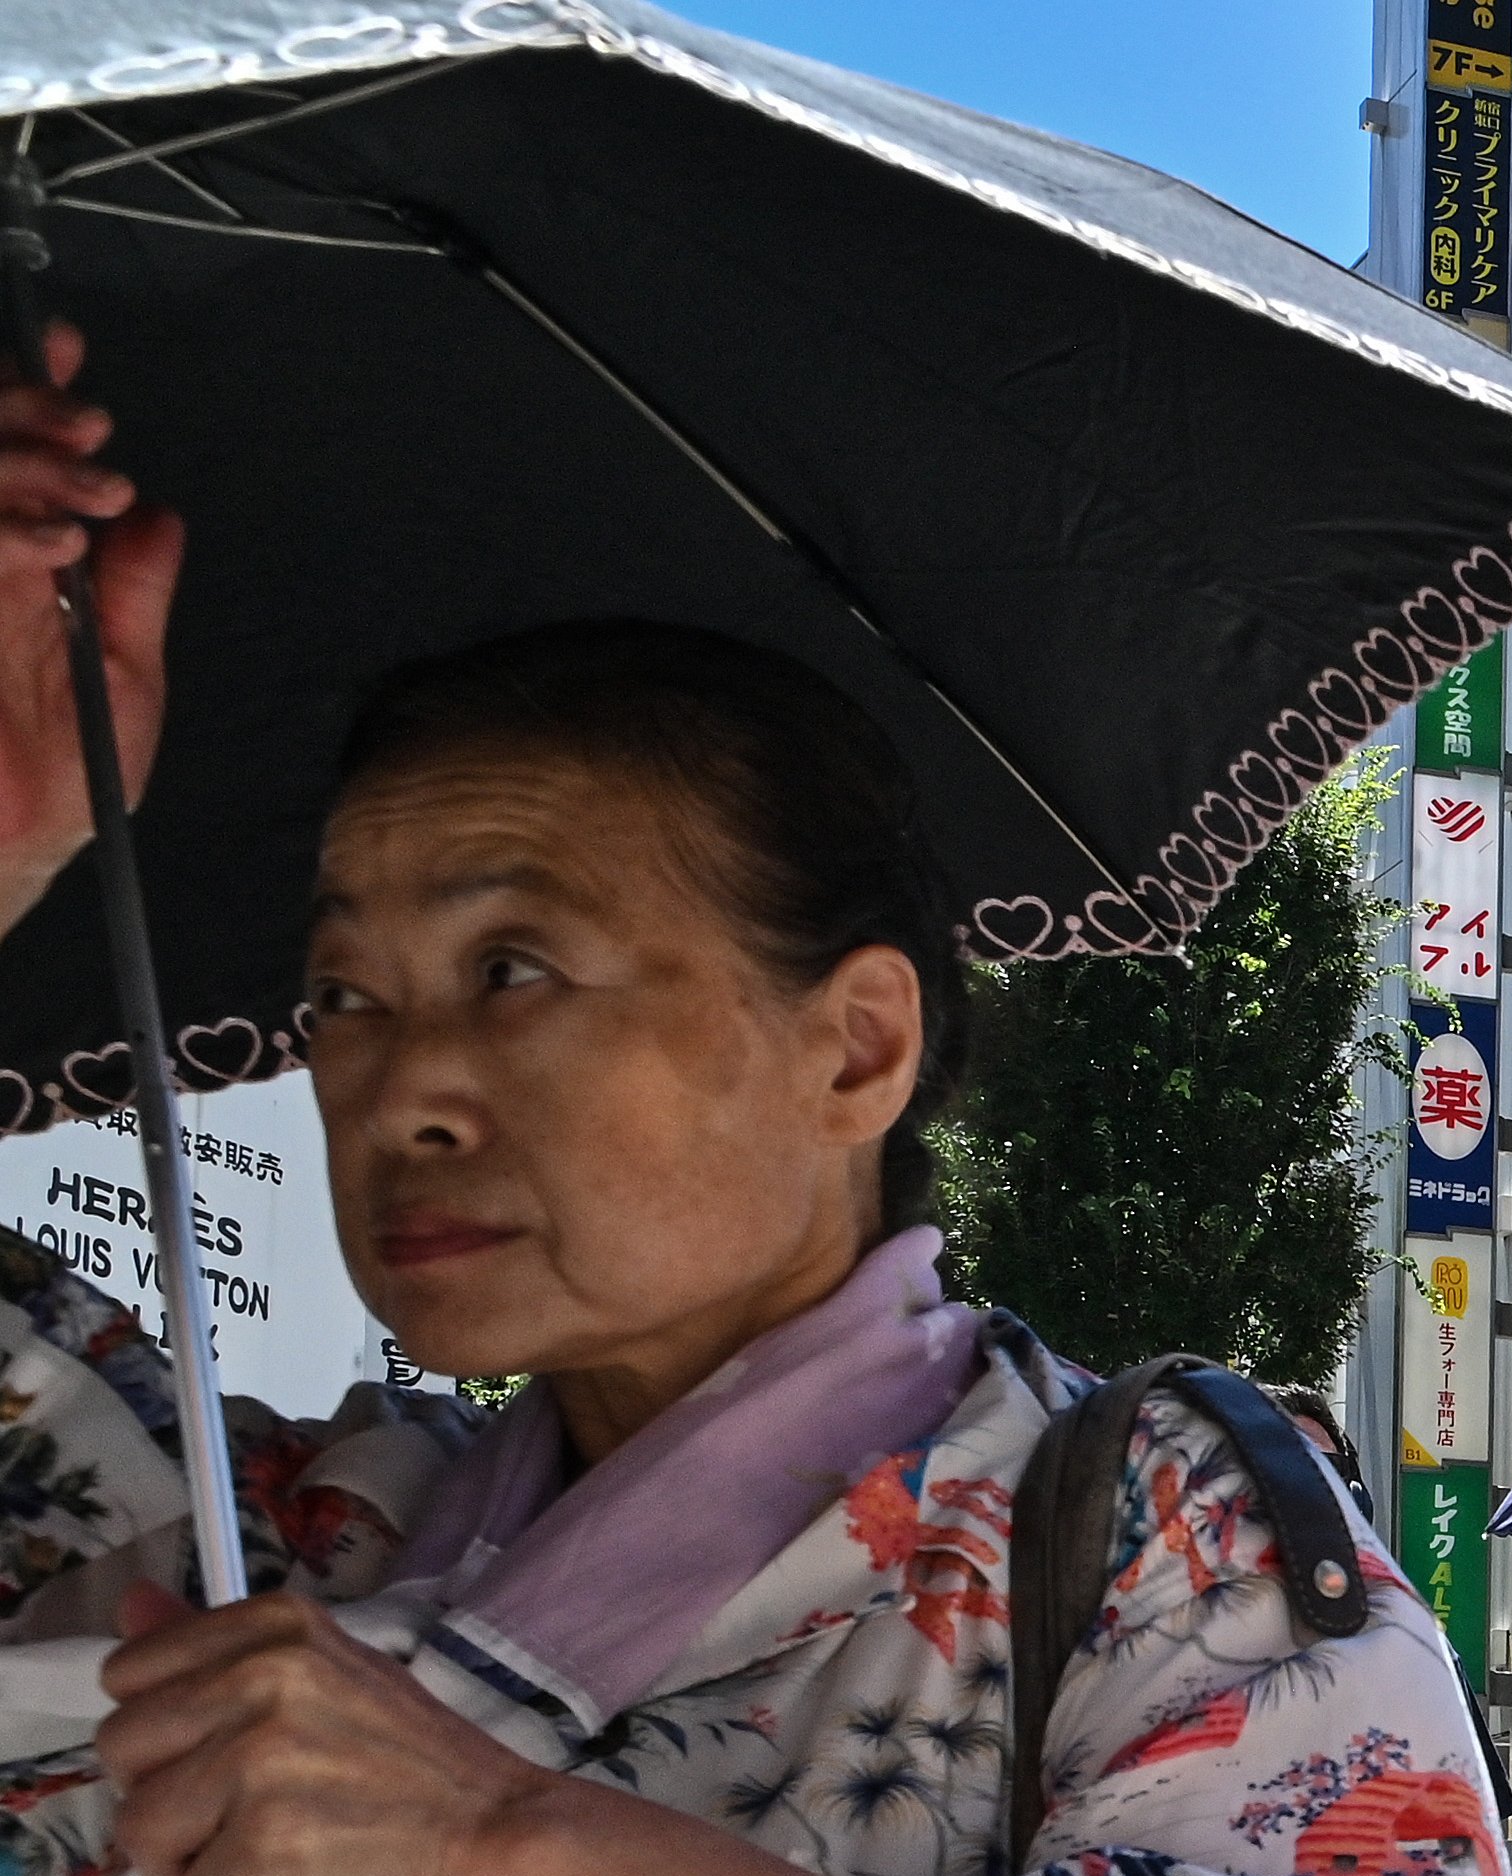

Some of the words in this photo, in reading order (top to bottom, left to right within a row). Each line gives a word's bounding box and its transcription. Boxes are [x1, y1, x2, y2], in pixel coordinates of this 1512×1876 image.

[1432, 46, 1474, 76] 7F
[1433, 100, 1462, 221] クリニック
[1470, 131, 1502, 305] プライマリケア
[1433, 234, 1457, 280] 内科
[1425, 289, 1454, 310] 6F
[1419, 943, 1492, 980] フル
[1418, 1066, 1484, 1134] 薬
[47, 1166, 244, 1258] HERÈS
[1436, 1321, 1458, 1447] 生フォー専門店
[1405, 1448, 1422, 1461] B1
